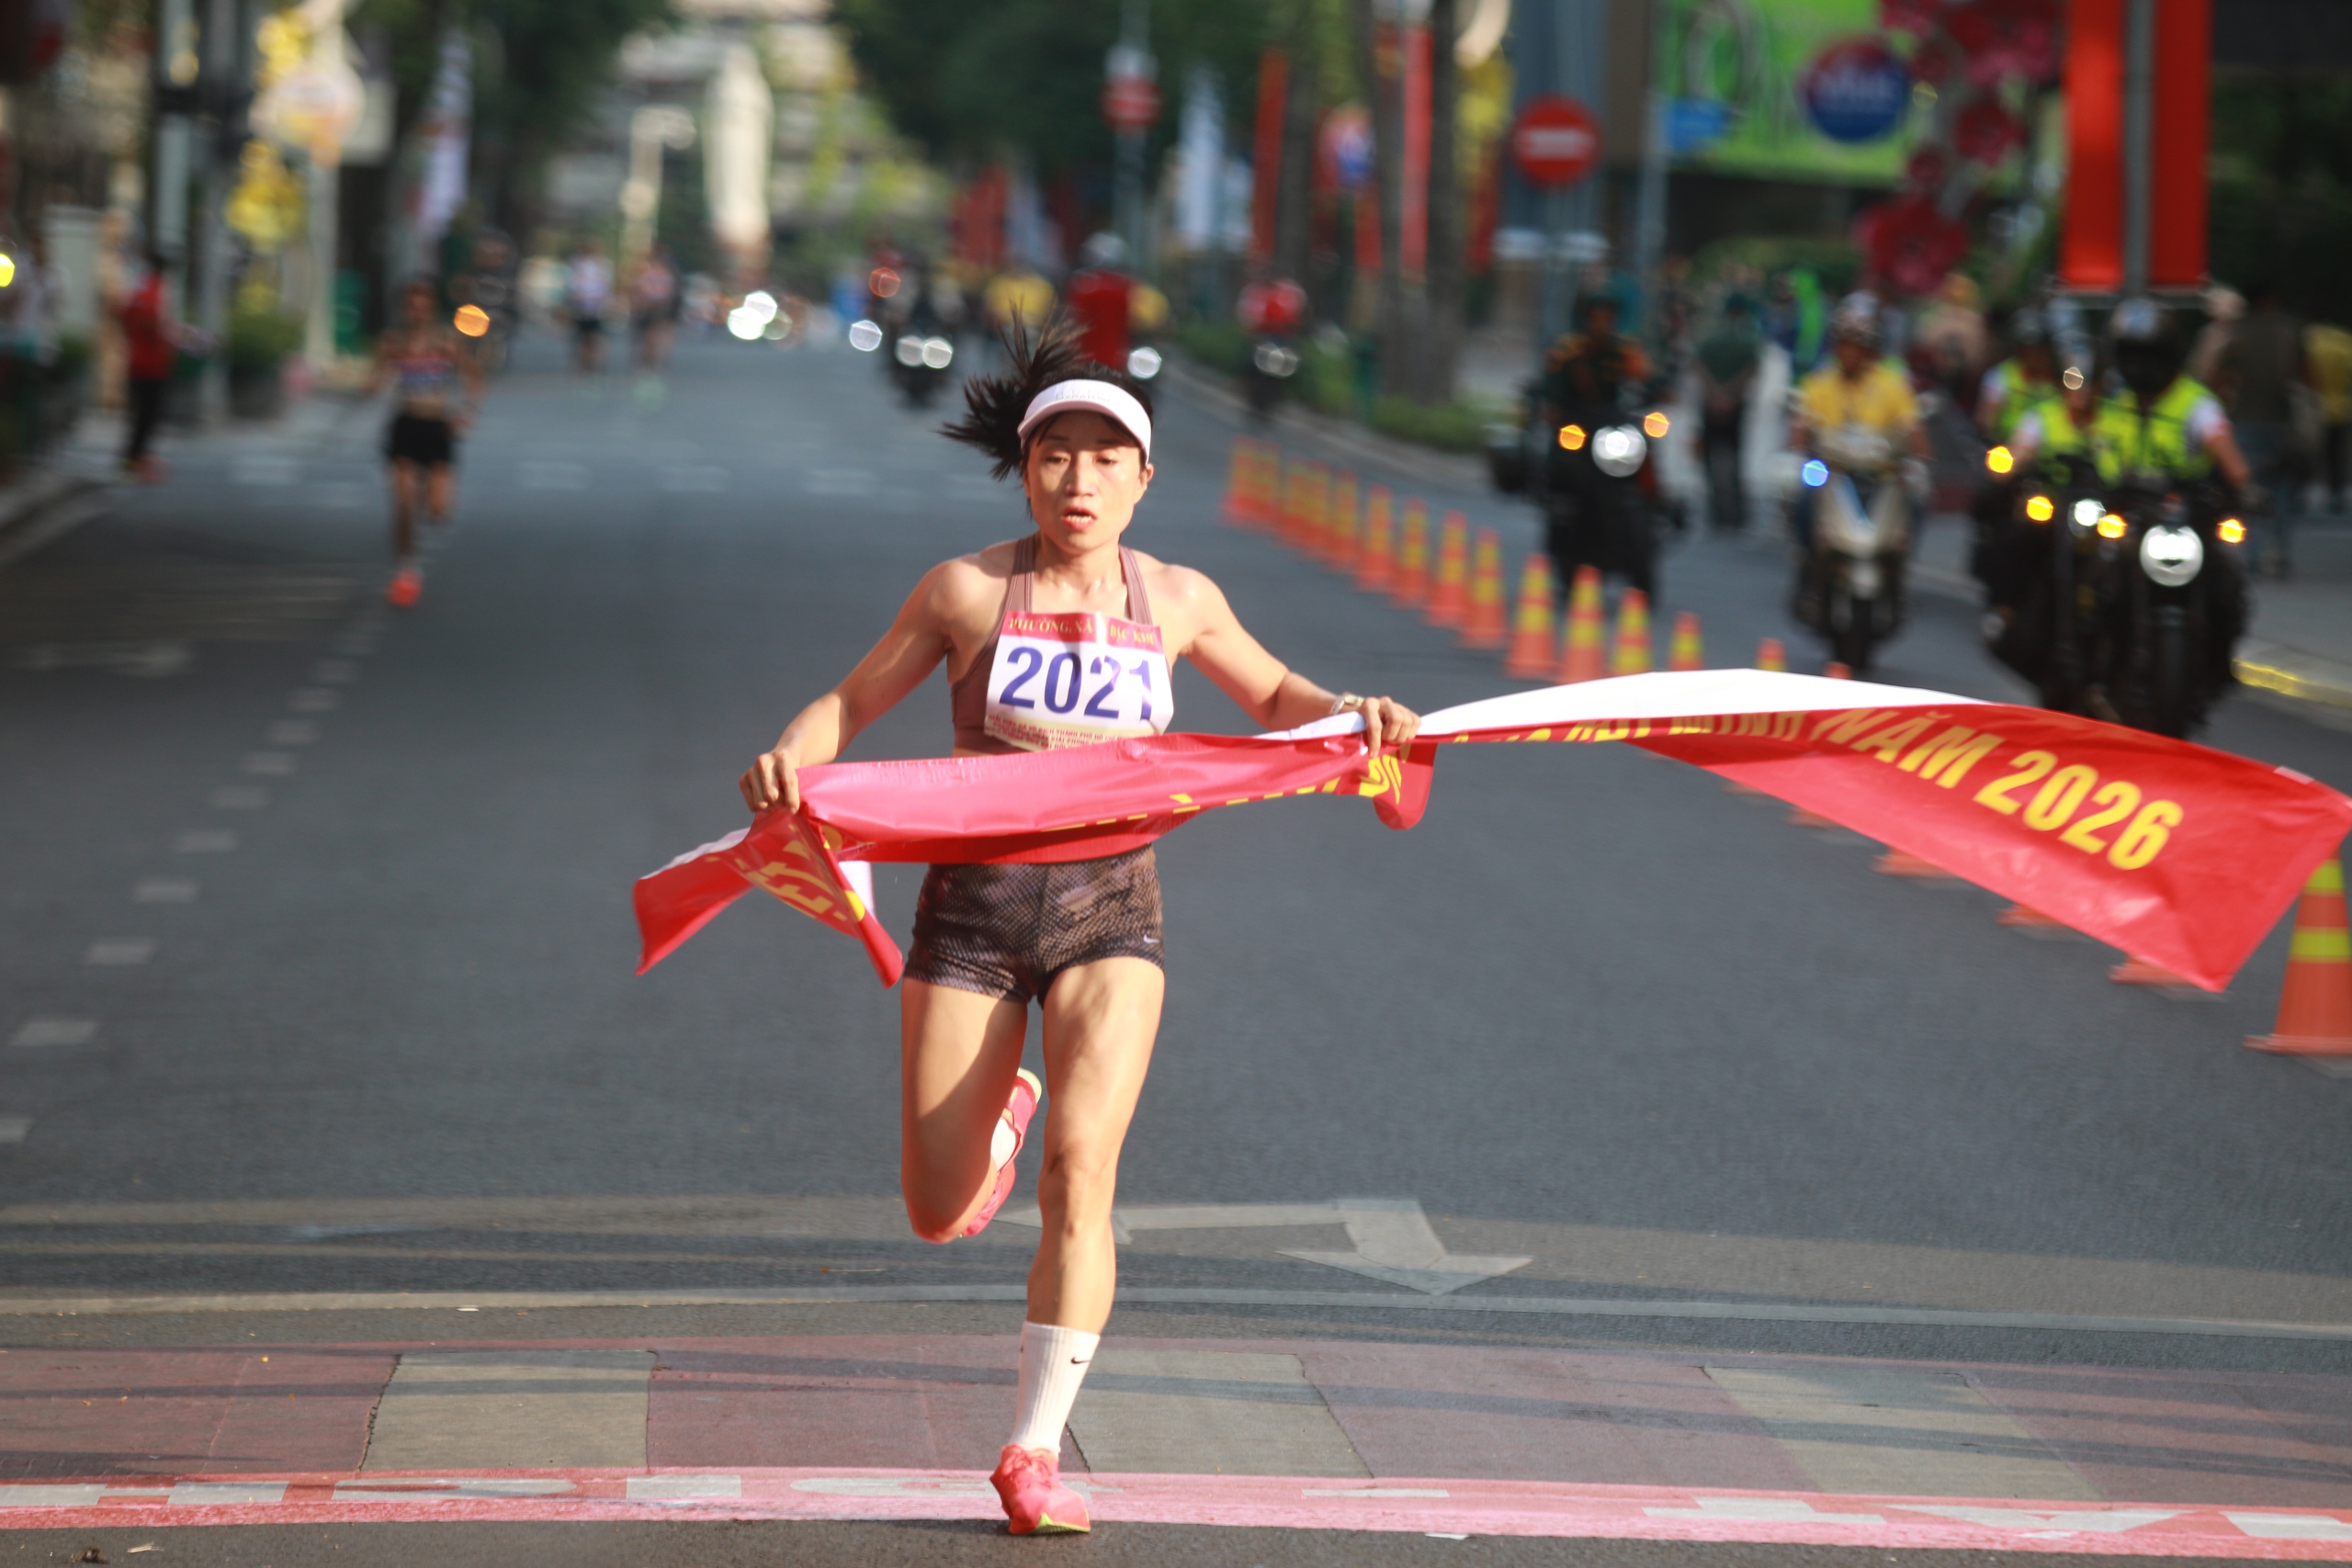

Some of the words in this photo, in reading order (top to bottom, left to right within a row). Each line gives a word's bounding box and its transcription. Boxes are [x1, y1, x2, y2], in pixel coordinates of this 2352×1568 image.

[999, 647, 1152, 720] 2021
[1808, 707, 2007, 789] NĂM
[1972, 749, 2184, 871] 2026
